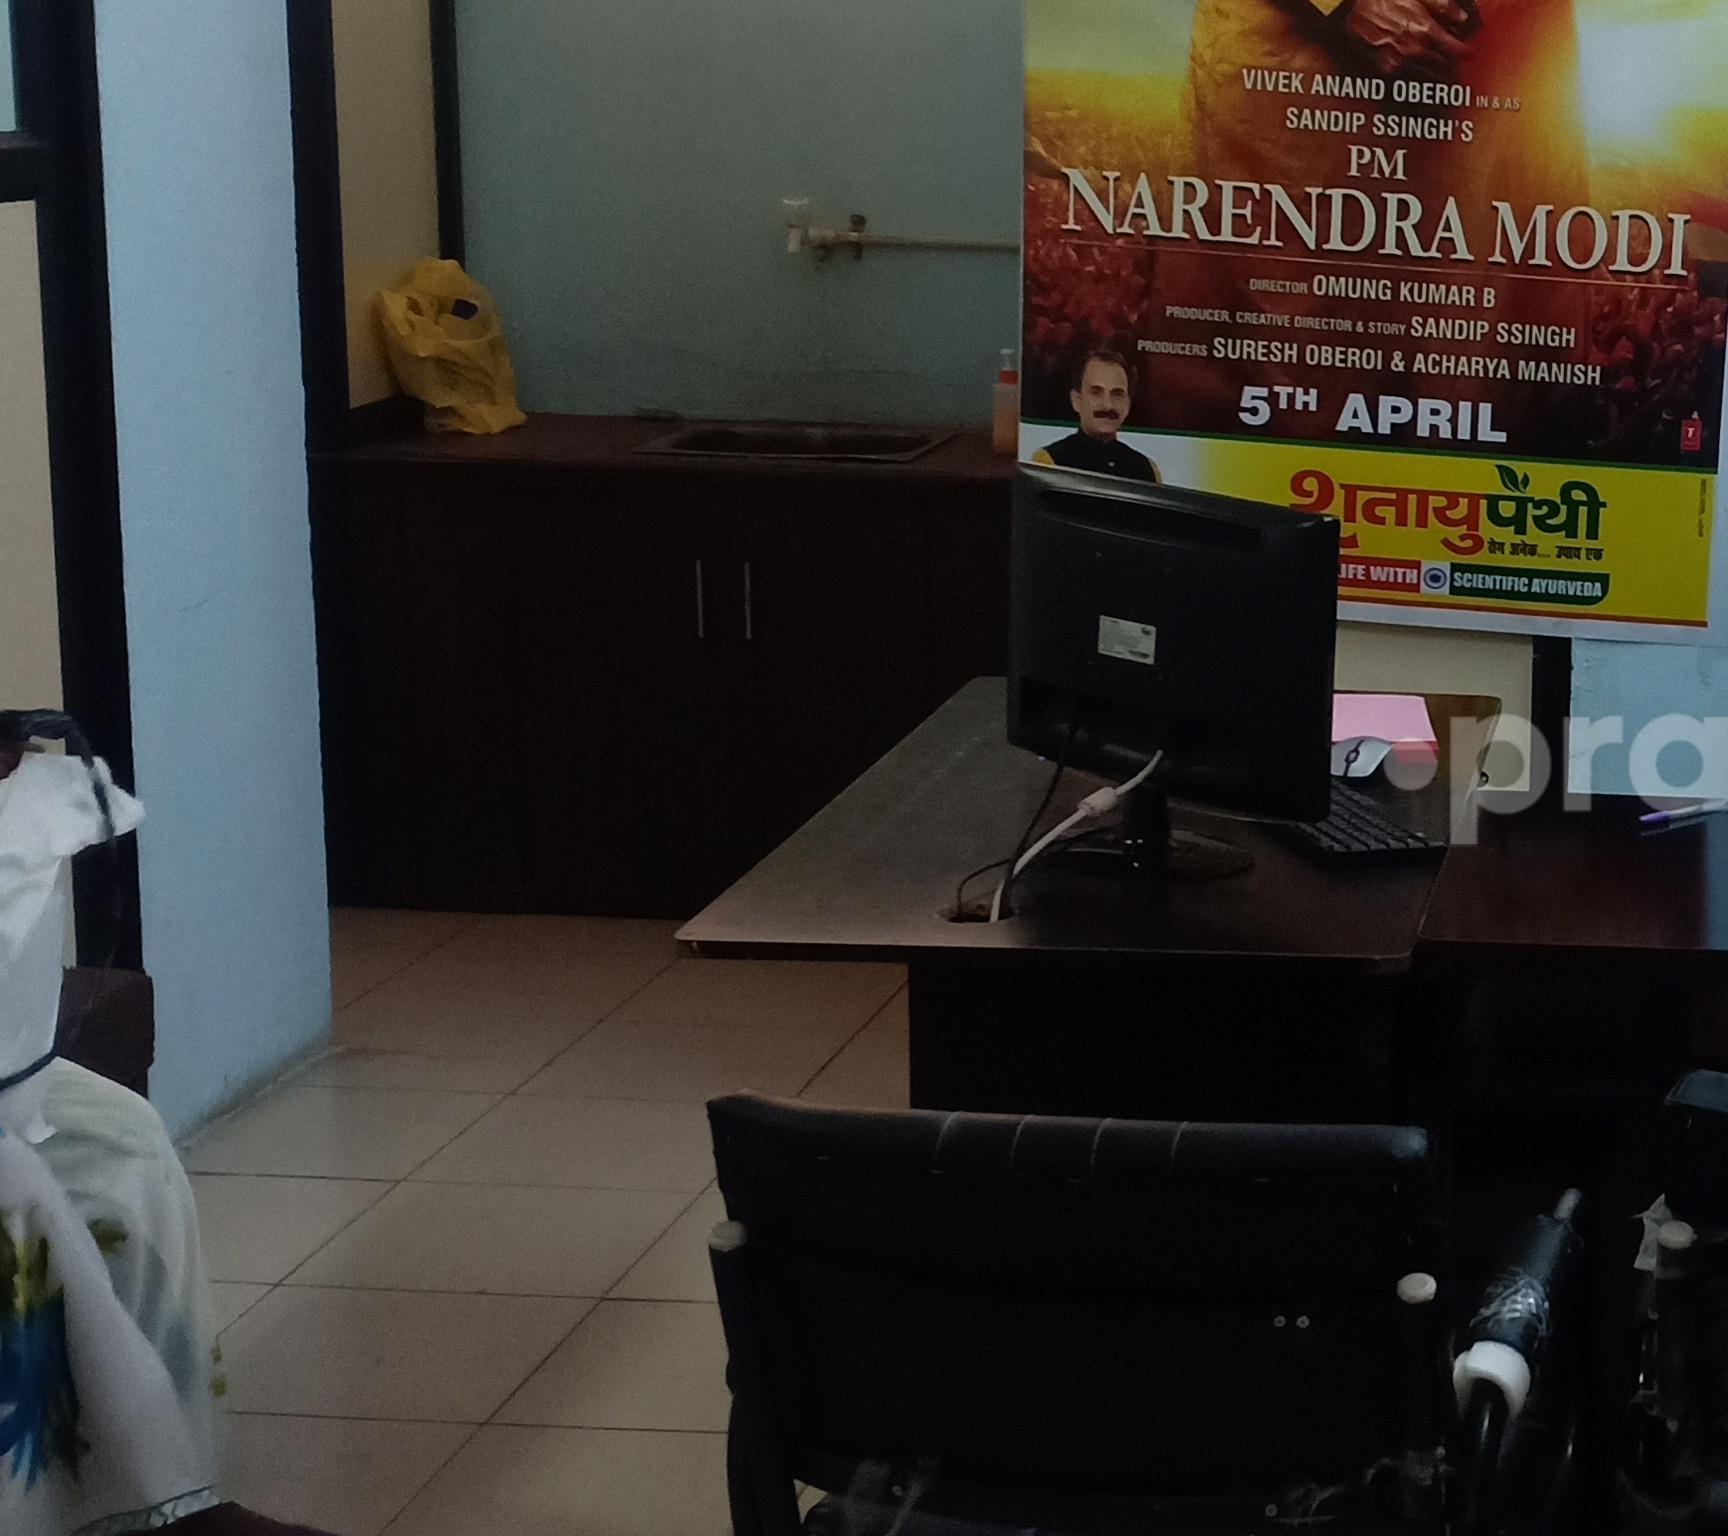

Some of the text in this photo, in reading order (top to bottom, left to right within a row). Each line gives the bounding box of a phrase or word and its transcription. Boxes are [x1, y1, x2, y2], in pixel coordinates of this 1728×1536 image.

[1242, 68, 1304, 94] VIVEK
[1311, 74, 1385, 100] ANAND
[1392, 80, 1471, 107] OBEROI
[1476, 96, 1488, 108] IN
[1504, 97, 1520, 110] AS
[1286, 106, 1474, 142] SANDIP SSINGH'S
[1347, 144, 1408, 181] PM
[1061, 166, 1692, 277] NARENDRA MODI
[1249, 274, 1496, 308] DIRECTOR OMUNG KUMAR B
[1236, 311, 1291, 328] CREATIVE
[1294, 316, 1352, 332] DIRECTOR
[1355, 321, 1364, 333] &
[1368, 322, 1406, 336] STORY
[1411, 316, 1489, 342] SANDIP
[1496, 322, 1575, 348] SSINGH
[1137, 336, 1601, 386] PRODUCERS SURESH OBEROI & ACHARYA MANISH
[1238, 384, 1507, 443] 5TH APRIL
[1370, 566, 1418, 584] WITH
[1453, 571, 1529, 592] SCIENTIFIC
[1531, 578, 1603, 597] AYURVEDA
